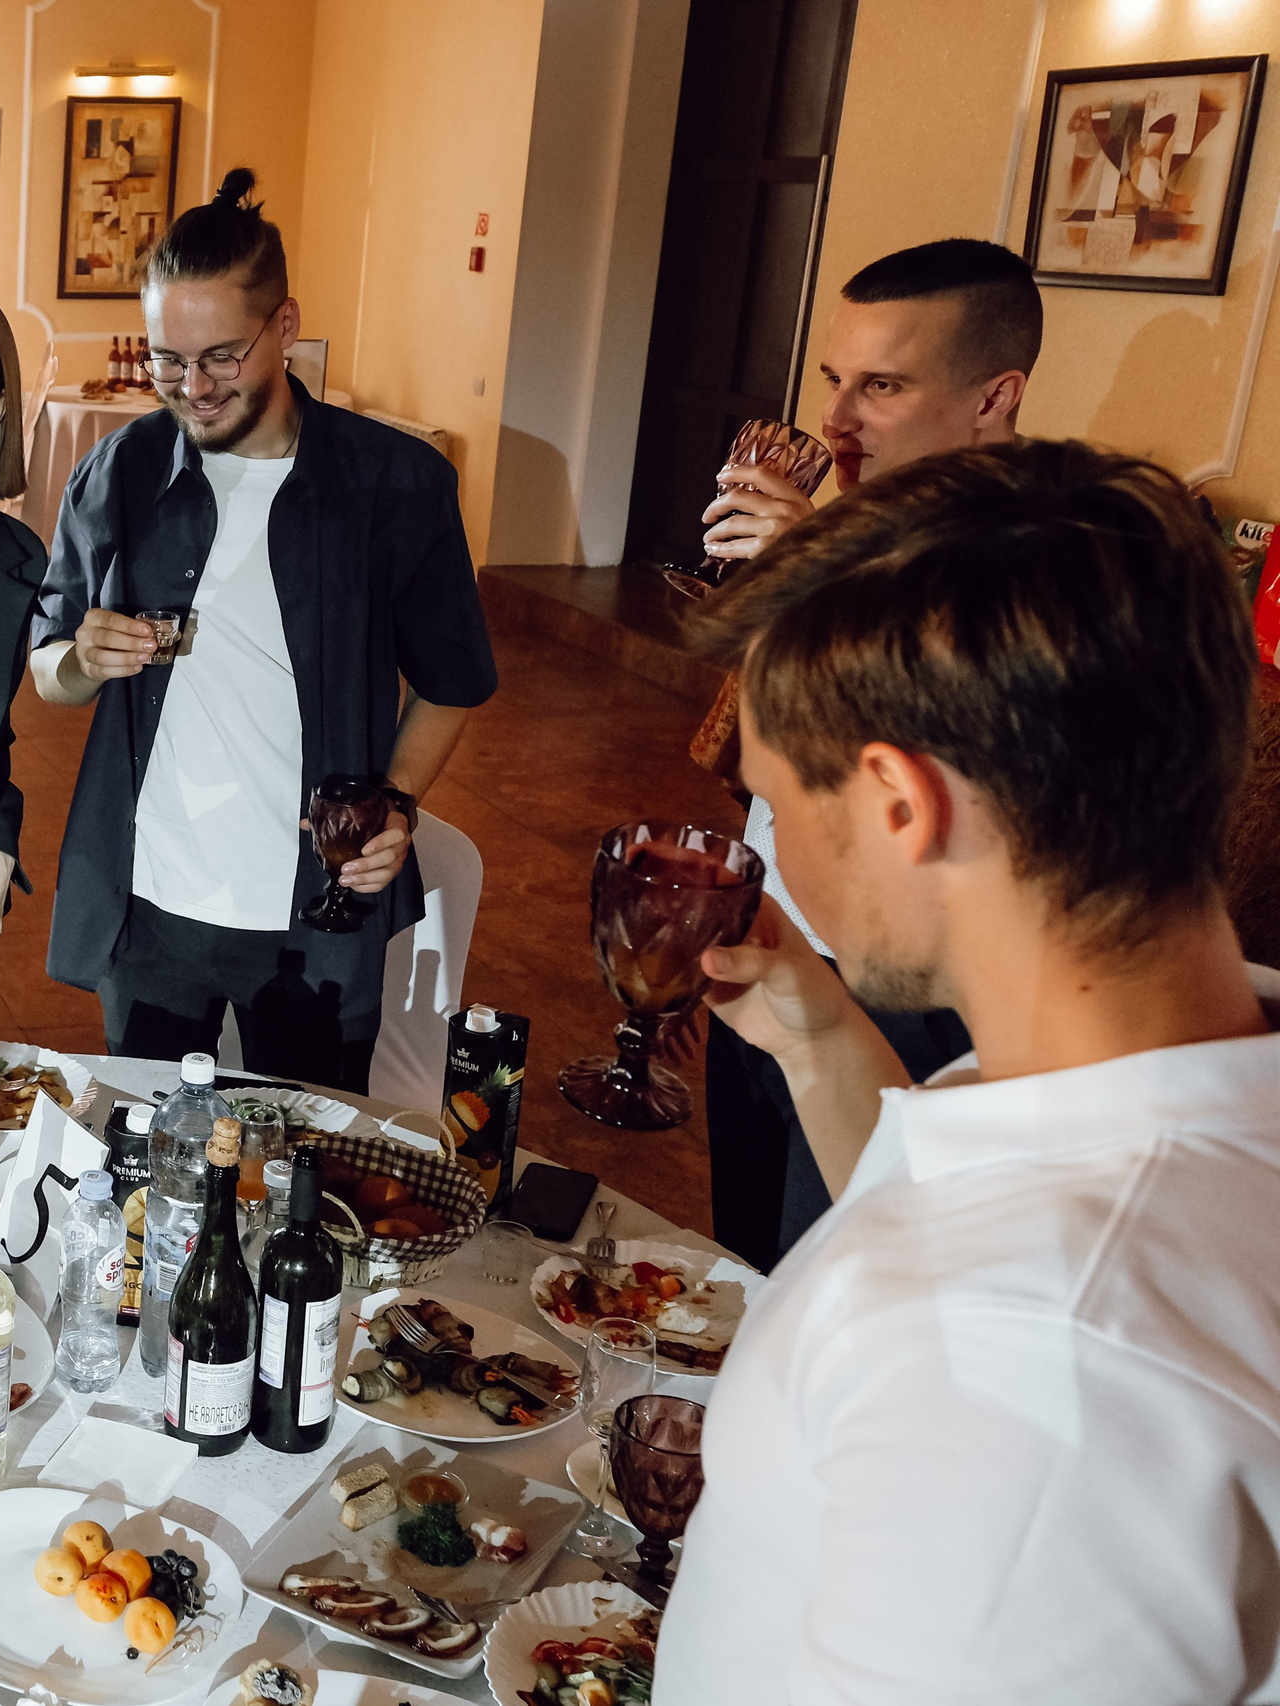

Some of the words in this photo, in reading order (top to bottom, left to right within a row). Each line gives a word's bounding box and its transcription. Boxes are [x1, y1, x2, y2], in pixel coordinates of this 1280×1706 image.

[450, 1055, 479, 1072] PREMIUM
[112, 1163, 150, 1179] PREMIUM
[189, 1403, 199, 1421] НЕ
[200, 1404, 238, 1423] ЯВЛЯЕТСЯ
